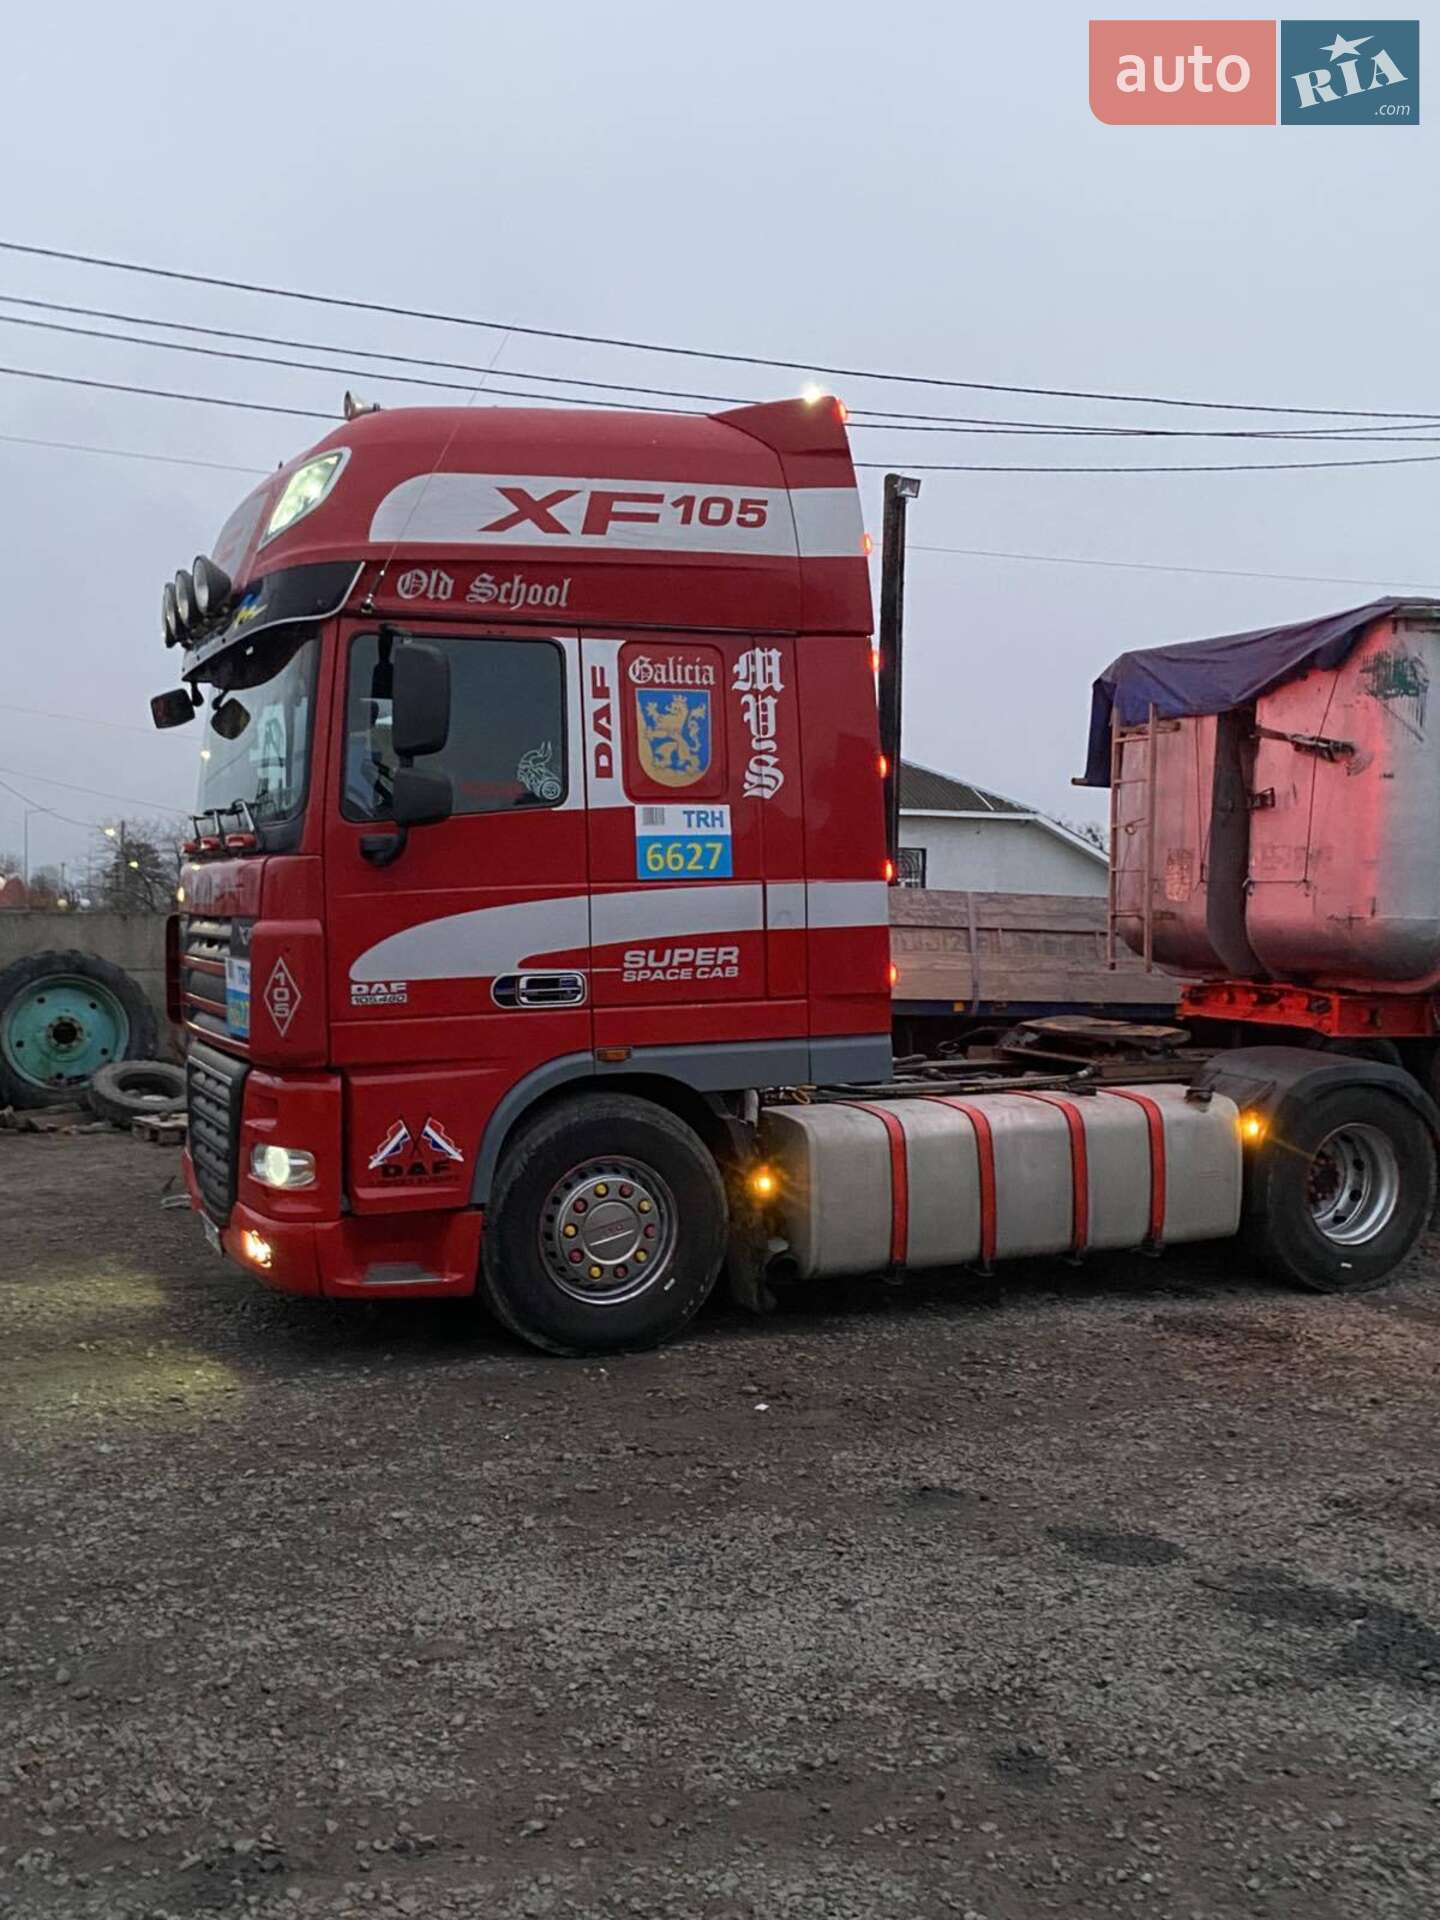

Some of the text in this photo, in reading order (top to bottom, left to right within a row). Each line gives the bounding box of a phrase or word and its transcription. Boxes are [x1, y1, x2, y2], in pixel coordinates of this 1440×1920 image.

[396, 568, 572, 611] Old School
[628, 656, 716, 686] Galicia
[591, 665, 614, 779] DAF
[683, 810, 725, 829] TRH
[645, 841, 723, 873] 6627
[623, 946, 740, 969] SUPER
[622, 966, 739, 982] SPACE CAB
[272, 971, 290, 1018] 105
[351, 982, 407, 995] DAF
[381, 1161, 450, 1178] DAF
